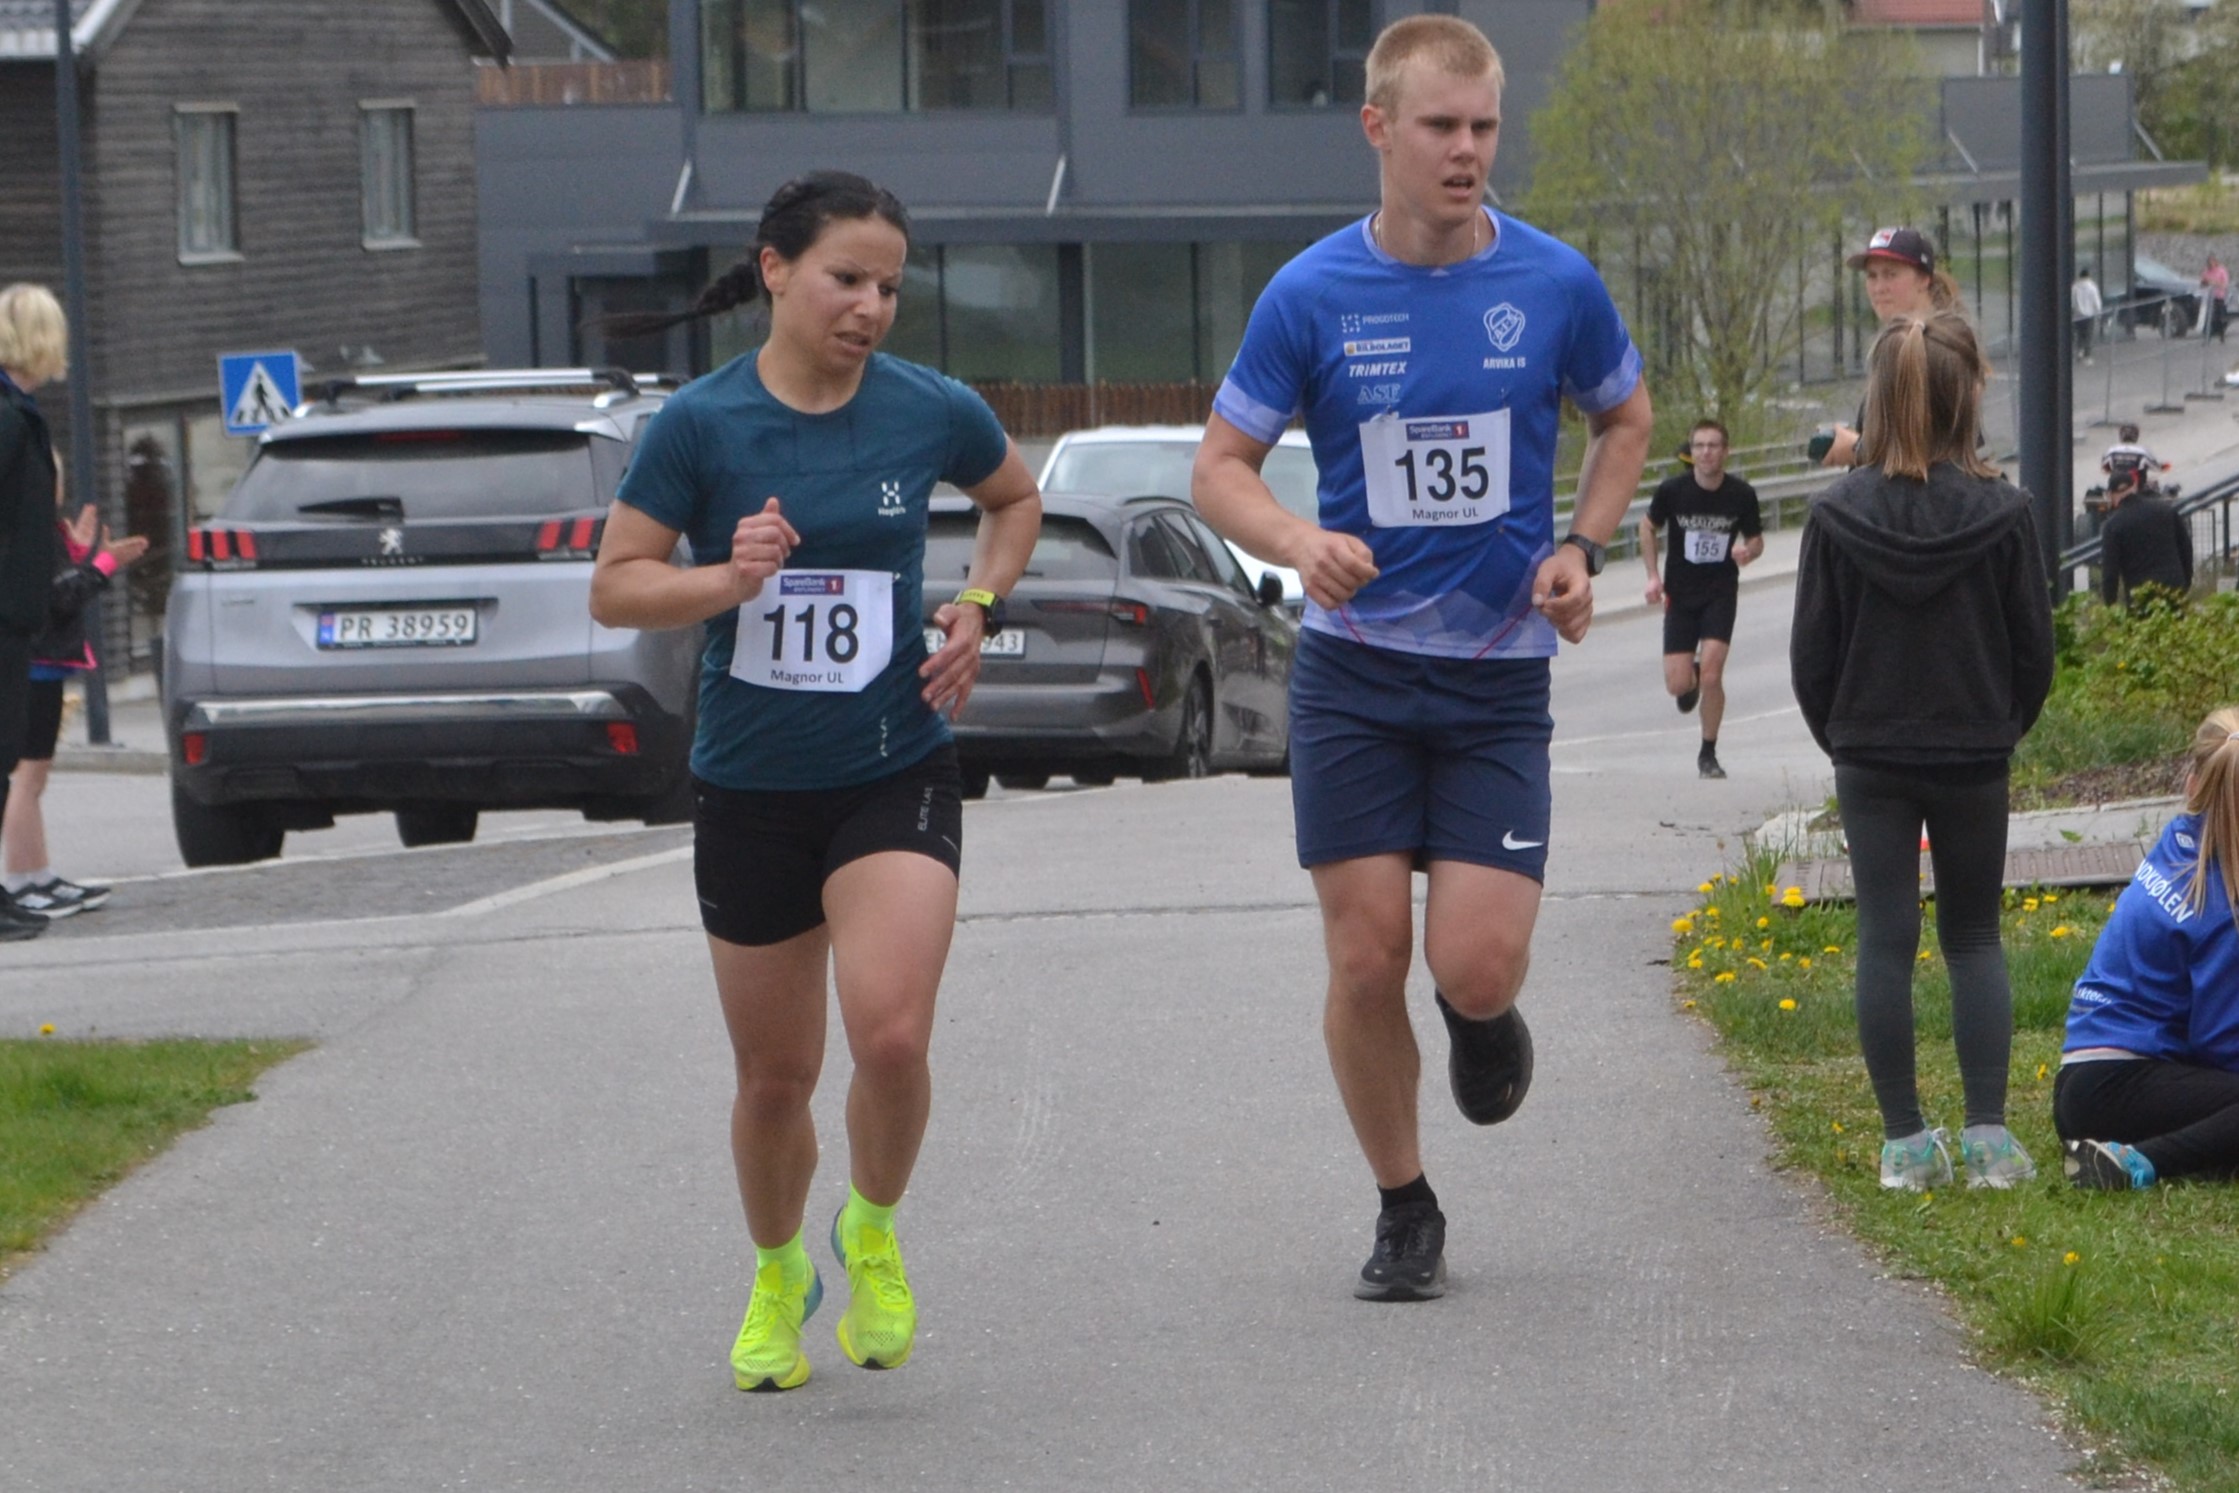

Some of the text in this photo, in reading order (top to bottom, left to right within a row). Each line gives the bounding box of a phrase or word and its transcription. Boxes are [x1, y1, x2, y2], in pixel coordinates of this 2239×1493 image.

[1348, 361, 1408, 378] TRIMTEX
[1483, 356, 1526, 369] ARVIKA IS
[1395, 446, 1489, 502] 135
[1412, 507, 1479, 521] Magnor UL
[1694, 541, 1719, 557] 155
[341, 614, 468, 640] PR 38959
[763, 603, 859, 664] 118
[770, 669, 844, 685] Magnor UL
